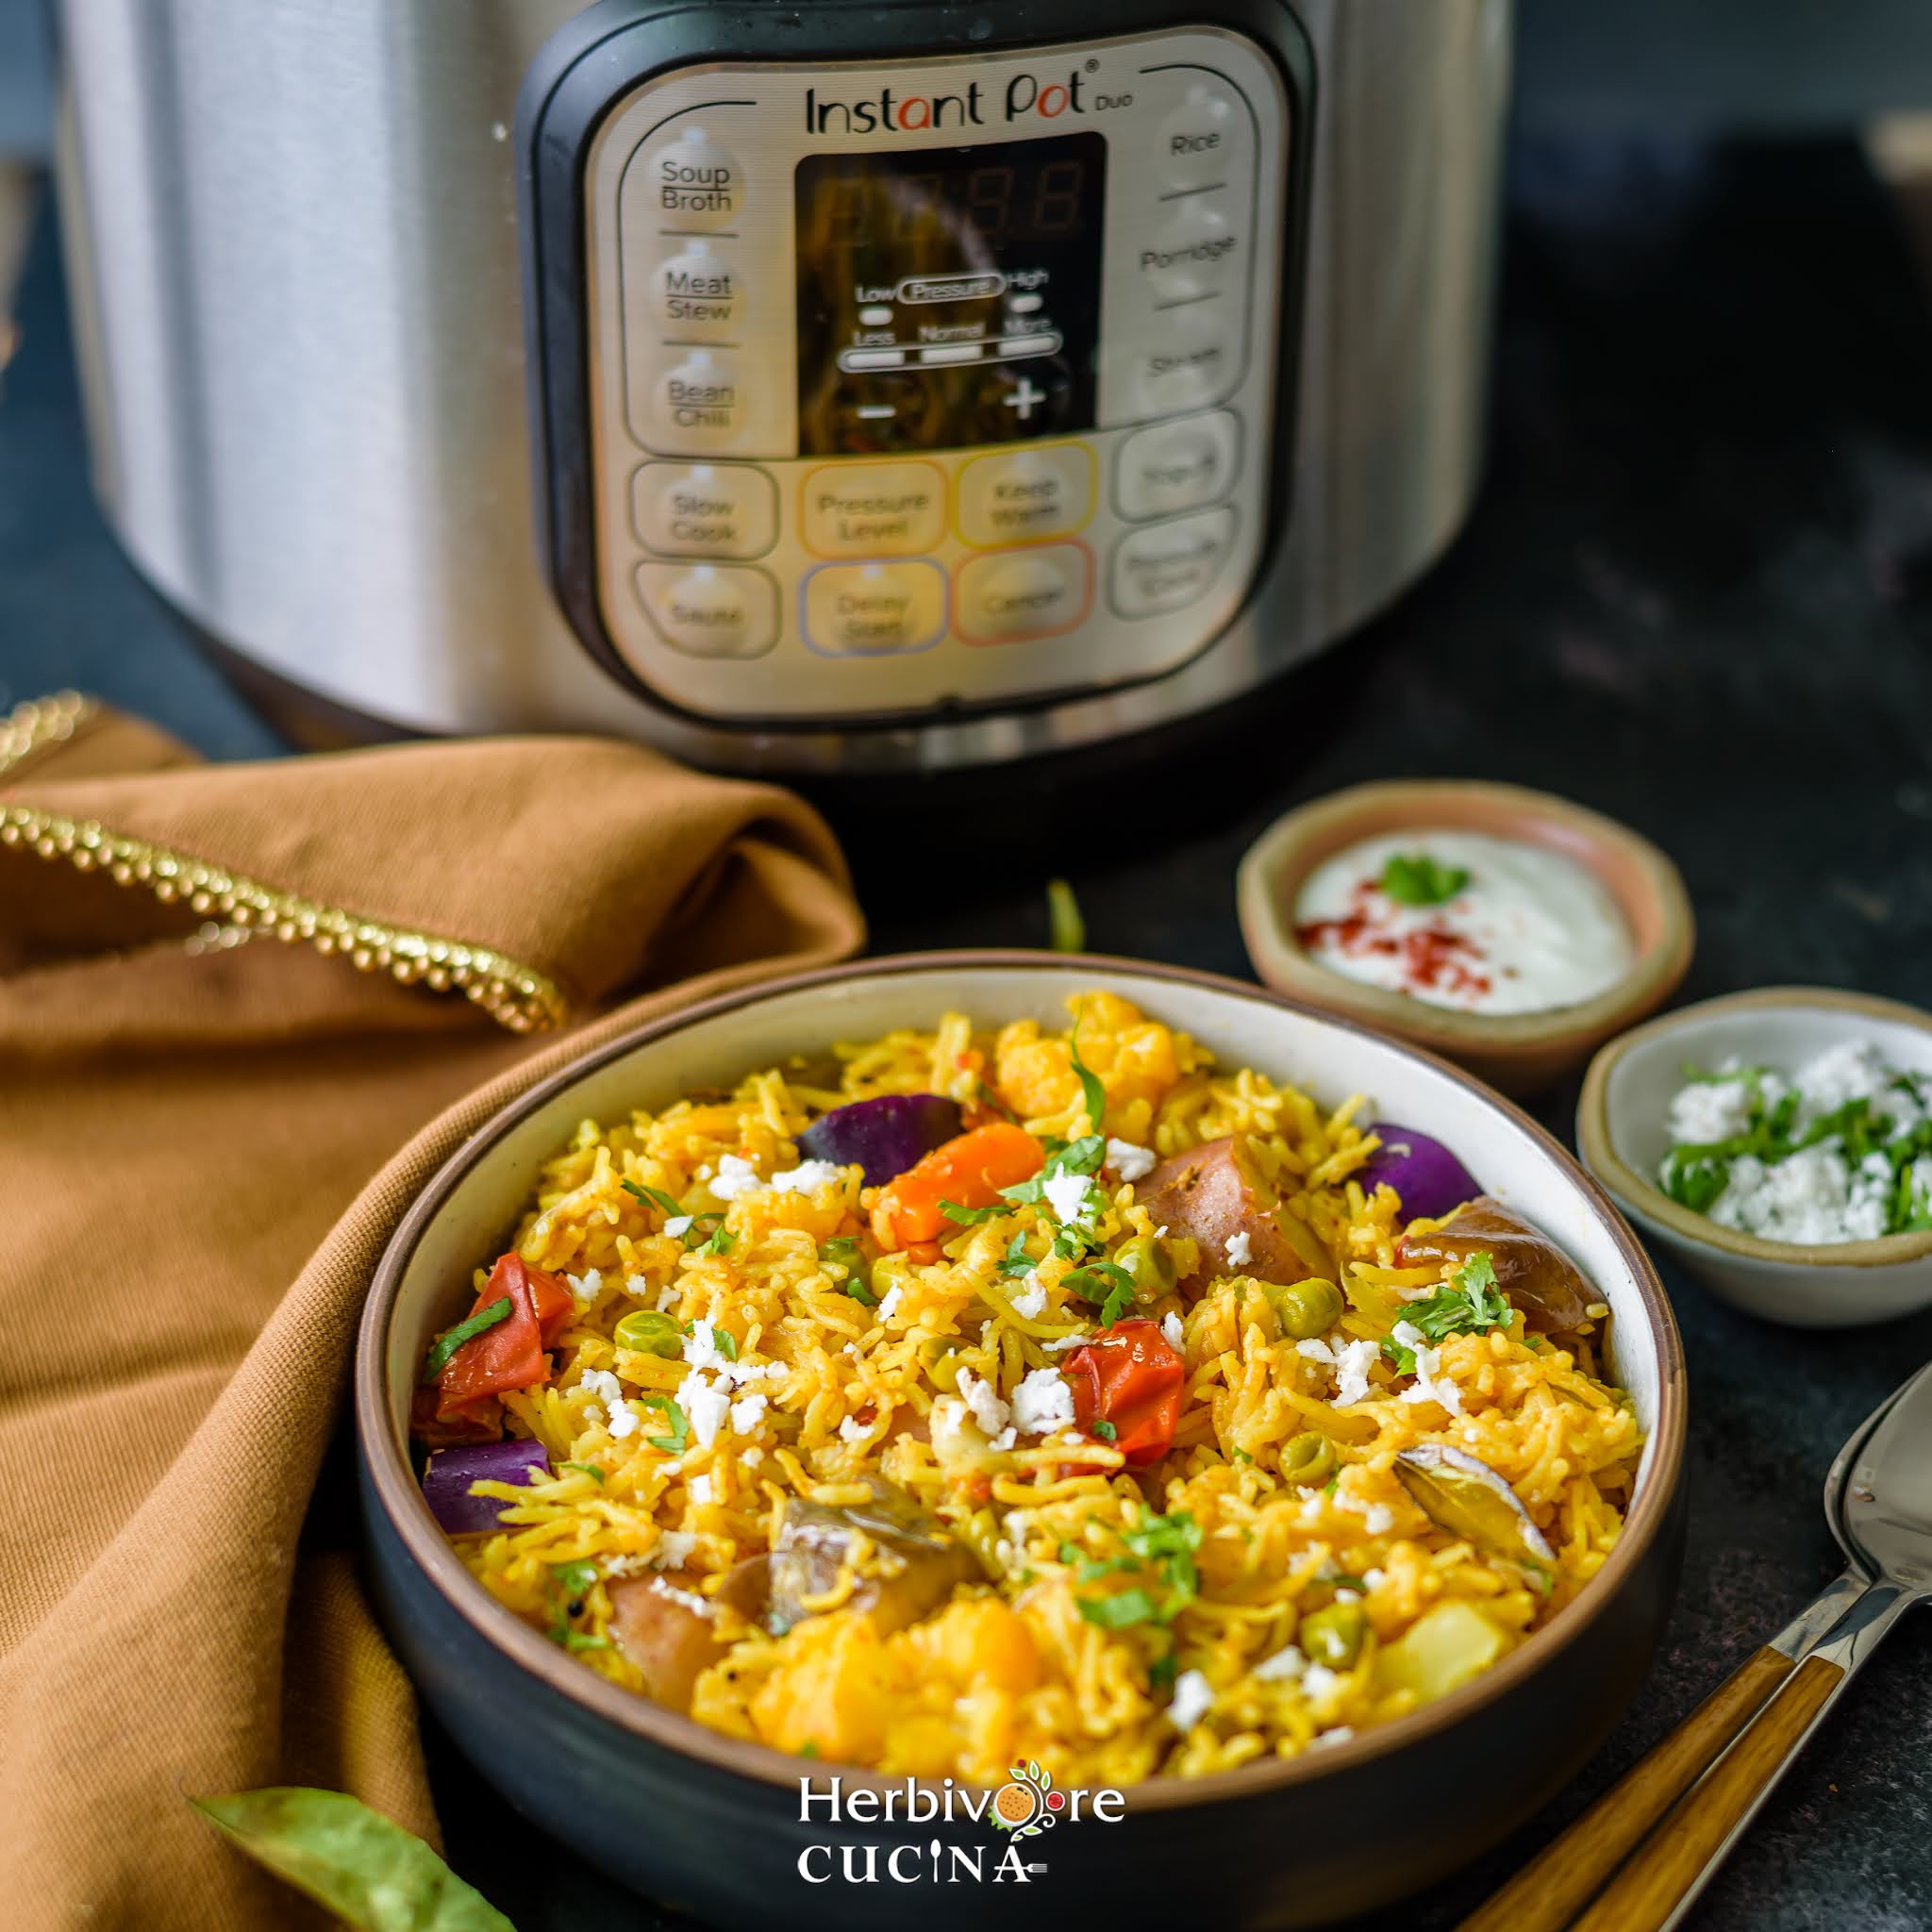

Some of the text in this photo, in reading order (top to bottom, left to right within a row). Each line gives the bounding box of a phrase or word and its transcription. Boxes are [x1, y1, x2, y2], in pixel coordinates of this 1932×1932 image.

[806, 87, 985, 134] Instant
[1171, 130, 1221, 157] Rice
[661, 161, 730, 189] Soup
[662, 191, 732, 212] Broth
[665, 272, 731, 295] Meat
[909, 281, 990, 300] Pressure
[855, 287, 897, 303] Low
[665, 301, 732, 321] Stew
[853, 331, 896, 347] Less
[669, 381, 735, 403] Bean
[673, 495, 735, 517] Slow
[839, 519, 909, 541] Level
